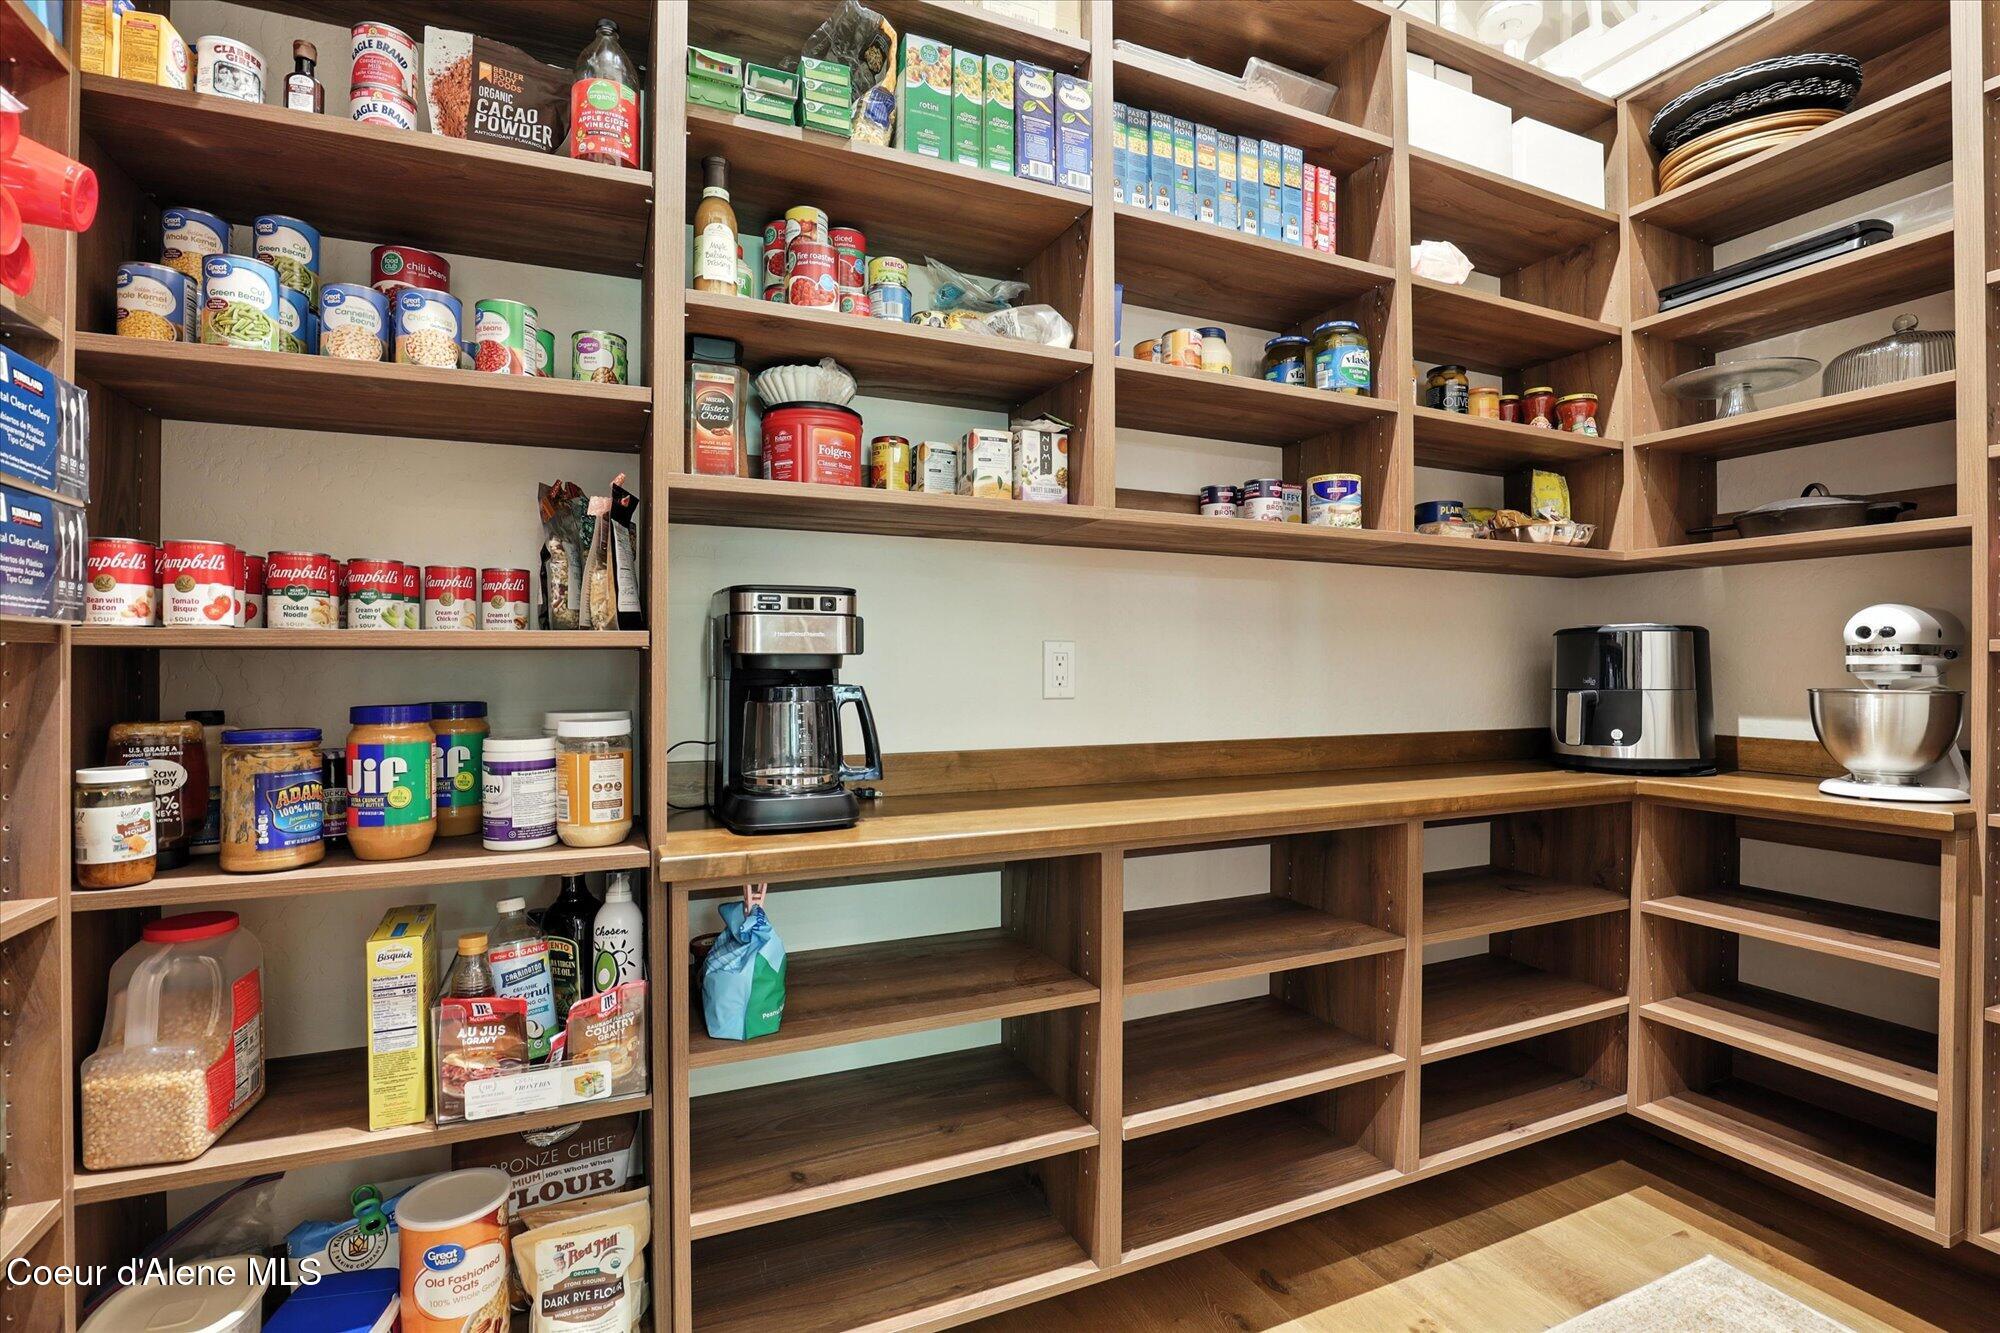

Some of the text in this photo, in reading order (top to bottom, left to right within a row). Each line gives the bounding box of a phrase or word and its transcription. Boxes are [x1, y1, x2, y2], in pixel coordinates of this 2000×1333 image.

[214, 44, 262, 71] CLABBER
[352, 39, 408, 70] EAGLE BRAND
[226, 54, 252, 69] GIRL
[494, 66, 524, 81] BETTER
[494, 73, 517, 85] BODY
[494, 80, 522, 93] FOODS
[1025, 80, 1047, 93] Penne
[478, 86, 514, 104] ORGANIC
[590, 94, 616, 103] organic
[1065, 92, 1086, 105] Penne
[352, 103, 378, 121] EAGLE
[476, 98, 538, 124] CACAO
[919, 101, 939, 112] rotini
[1128, 110, 1147, 119] PASTA
[1151, 113, 1170, 122] PASTA
[578, 116, 629, 129] APPLE CIDER
[584, 122, 622, 133] VINEGAR
[1128, 116, 1147, 127] RONI
[1152, 120, 1171, 130] RONI
[1174, 120, 1192, 130] PASTA
[474, 112, 553, 148] POWDER
[1174, 128, 1193, 138] RONI
[1197, 126, 1215, 135] PASTA
[1197, 132, 1216, 142] RONI
[1219, 136, 1236, 144] PASTA
[1218, 142, 1236, 151] RONI
[1240, 140, 1258, 149] PASTA
[1262, 142, 1280, 151] PASTA
[1240, 146, 1258, 156] RONI
[1262, 149, 1280, 160] RONI
[1284, 146, 1301, 156] PASTA
[1284, 153, 1301, 163] RONI
[164, 216, 181, 225] Great
[256, 222, 273, 231] Great
[166, 234, 218, 249] Whole Kernel
[834, 235, 853, 243] diced
[258, 244, 307, 260] Green Beans
[293, 243, 307, 251] Cut
[810, 253, 835, 264] roasted
[207, 264, 228, 272] Great
[884, 261, 905, 270] HATCH
[406, 262, 447, 282] chili beans
[137, 292, 168, 303] Kernel
[210, 288, 265, 305] Green Beans
[251, 287, 265, 296] Cut
[325, 293, 341, 301] Great
[334, 308, 376, 320] Cannellini
[350, 316, 375, 328] Beans
[10, 396, 50, 425] Clear Cutlery
[701, 402, 731, 413] Taster's
[700, 412, 729, 421] Choice
[7, 433, 18, 445] Tipo
[819, 444, 852, 460] Folgers
[1041, 435, 1051, 471] NUMI
[818, 460, 837, 468] Classic
[9, 534, 50, 554] Clear Cutlery
[6, 574, 18, 583] Tipo
[268, 564, 327, 581] Campbell's
[425, 574, 473, 590] Campbell's
[86, 596, 125, 604] Bean with
[92, 604, 117, 612] Bacon
[282, 604, 309, 612] Chicken
[348, 756, 408, 794] Jif
[279, 804, 302, 817] 100%
[124, 826, 150, 836] HONEY
[594, 926, 629, 938] Chosen
[508, 944, 545, 958] ORGANIC
[377, 952, 413, 963] Bisquick
[505, 962, 542, 982] CARRINGTON
[561, 968, 572, 977] OIL
[585, 1016, 635, 1037] COUNTRY
[586, 1020, 612, 1030] SAUSAGE
[457, 1025, 506, 1039] AU JUS
[598, 1028, 626, 1041] GRAVY
[466, 1036, 497, 1045] GRAVY
[568, 1136, 614, 1158] CHIEF
[545, 1158, 615, 1178] 100% Whole Wheat
[428, 1248, 458, 1262] Great
[568, 1232, 618, 1269] Red Mill
[356, 1245, 382, 1269] COMPANY
[434, 1256, 459, 1266] Value
[424, 1254, 501, 1290] Old Fashioned
[573, 1269, 597, 1277] ORGANIC
[452, 1279, 480, 1296] Oats
[564, 1276, 606, 1289] STONE GROUND
[429, 1288, 480, 1309] 100% Whole
[544, 1282, 623, 1309] DARK RYE FLOUR
[554, 1307, 588, 1319] WHOLE GRAIN
